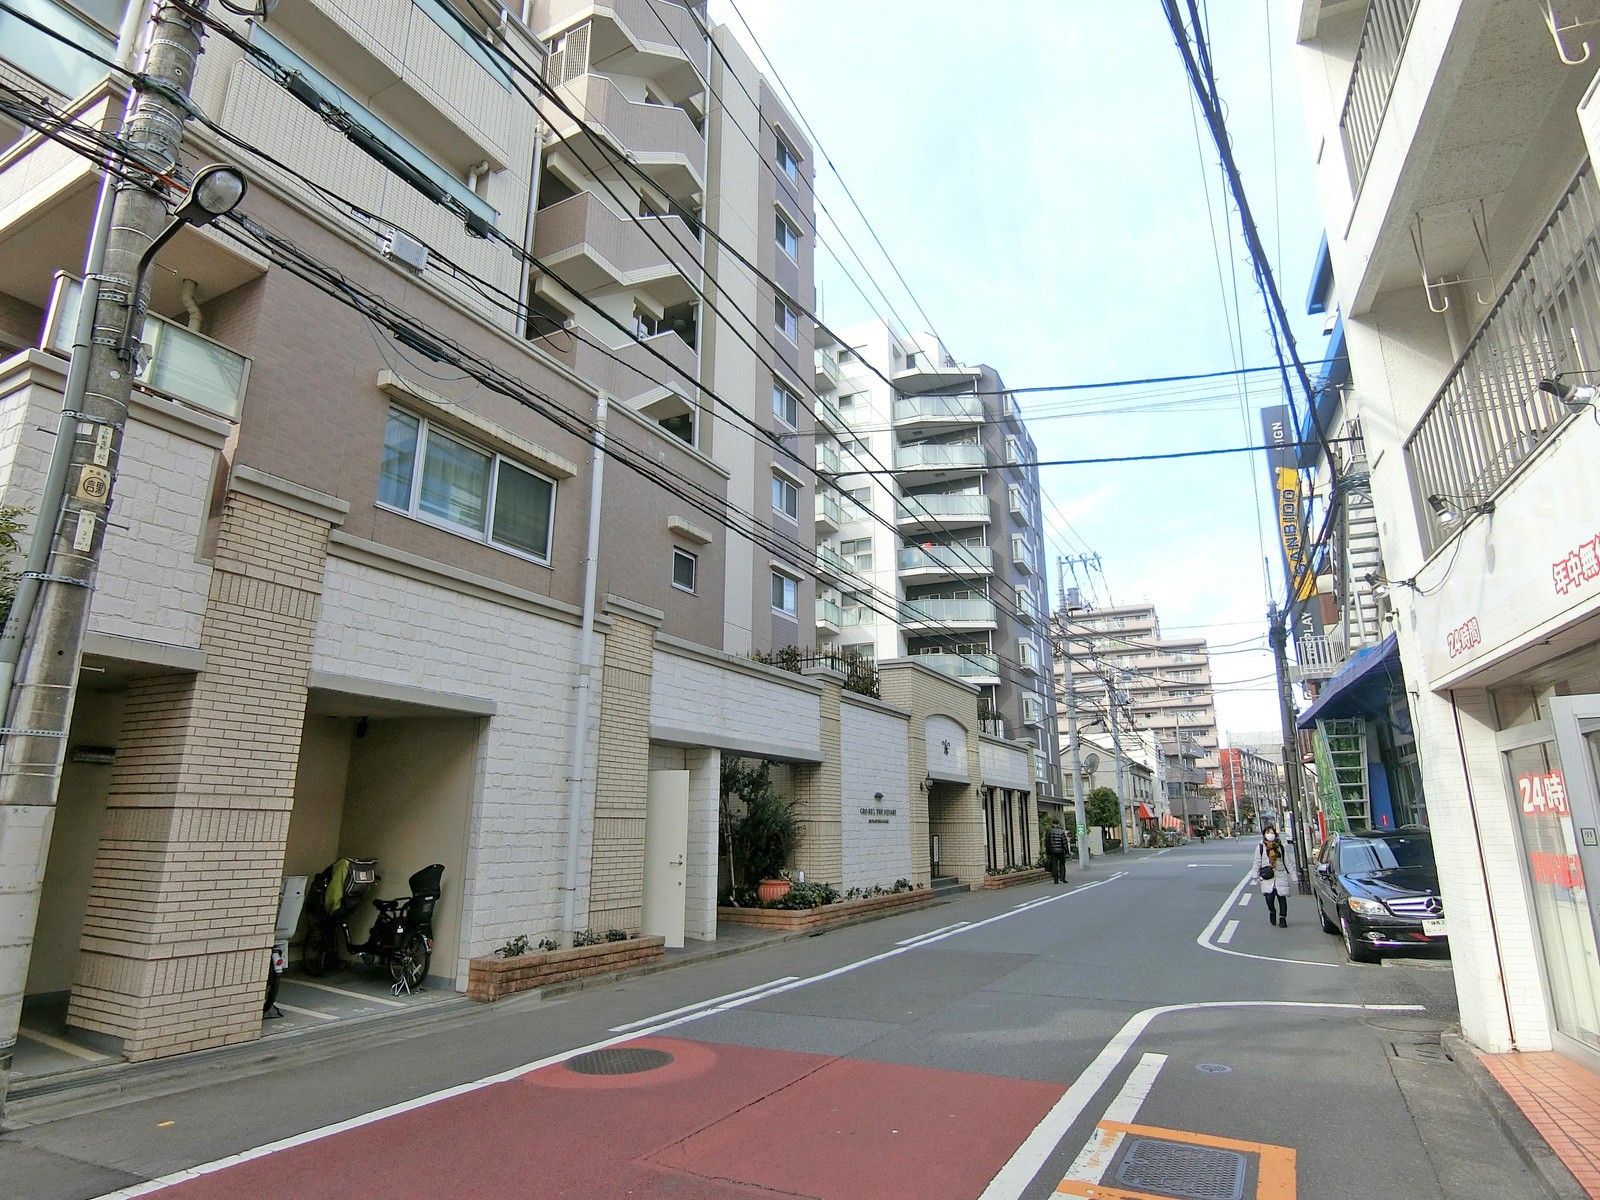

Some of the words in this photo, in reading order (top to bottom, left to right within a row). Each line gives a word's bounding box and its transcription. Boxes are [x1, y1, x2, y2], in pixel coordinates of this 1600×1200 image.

[1282, 489, 1306, 576] SANBIDO
[1447, 616, 1481, 658] 24時間
[1517, 770, 1570, 816] 24時
